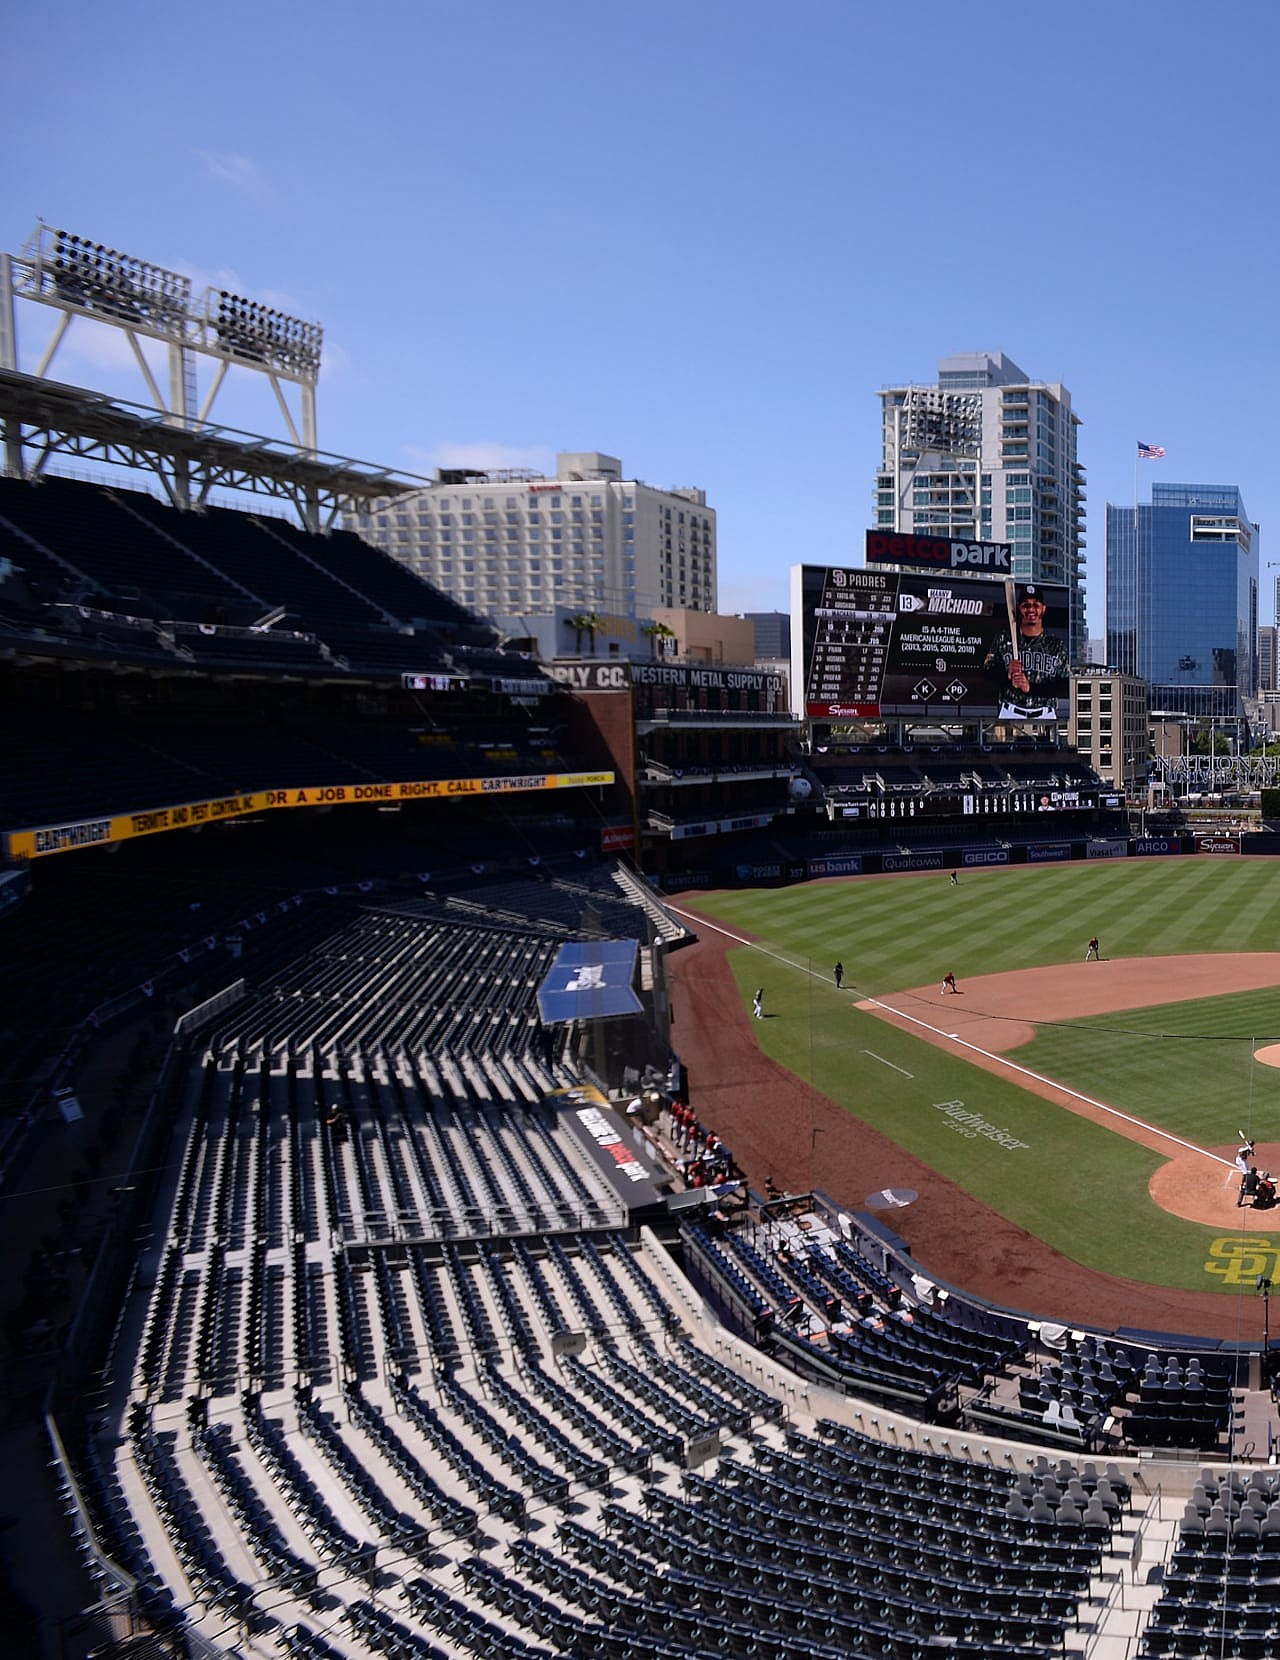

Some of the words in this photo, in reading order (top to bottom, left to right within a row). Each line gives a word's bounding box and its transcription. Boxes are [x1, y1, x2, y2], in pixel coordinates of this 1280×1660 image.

[869, 534, 948, 561] petco
[950, 542, 1009, 567] park
[849, 573, 886, 588] PADRES
[902, 596, 913, 610] 13
[927, 597, 984, 615] MACHADO
[922, 625, 929, 634] IS
[930, 626, 936, 634] A
[937, 626, 961, 635] 4-TIME
[900, 633, 932, 643] AMERICAN
[932, 635, 955, 644] LEAGUE
[955, 636, 982, 645] ALL-STAR
[901, 642, 921, 652] (2013,
[922, 643, 939, 653] 2015,
[940, 644, 957, 653] 2016,
[1003, 650, 1057, 676] PDRES
[595, 666, 630, 688] CO.
[631, 665, 686, 686] WESTERN
[690, 670, 726, 688] METAL
[727, 673, 763, 691] SUPPLY
[766, 675, 783, 691] CO.
[823, 674, 842, 682] PROFAR
[821, 683, 840, 691] HEDGES
[921, 685, 929, 694] K
[951, 686, 963, 695] P6
[1165, 770, 1274, 784] UNIVERSITY
[297, 790, 307, 803] A
[316, 788, 346, 801] JOB
[354, 785, 393, 799] DONE
[400, 782, 442, 796] RIGHT,
[447, 780, 476, 793] CALL
[481, 776, 546, 791] CARTWRIGHT
[130, 811, 169, 833] TERMITE
[172, 807, 189, 825] AND
[191, 803, 209, 821] PEST
[1138, 841, 1168, 853] ARCO
[1200, 838, 1234, 853] Sycuan
[964, 852, 1008, 864] GEICO
[1030, 849, 1064, 859] Southwest
[884, 857, 941, 869] Qualcomm
[932, 1099, 1030, 1151] Budweiser
[941, 1120, 978, 1139] ZERO
